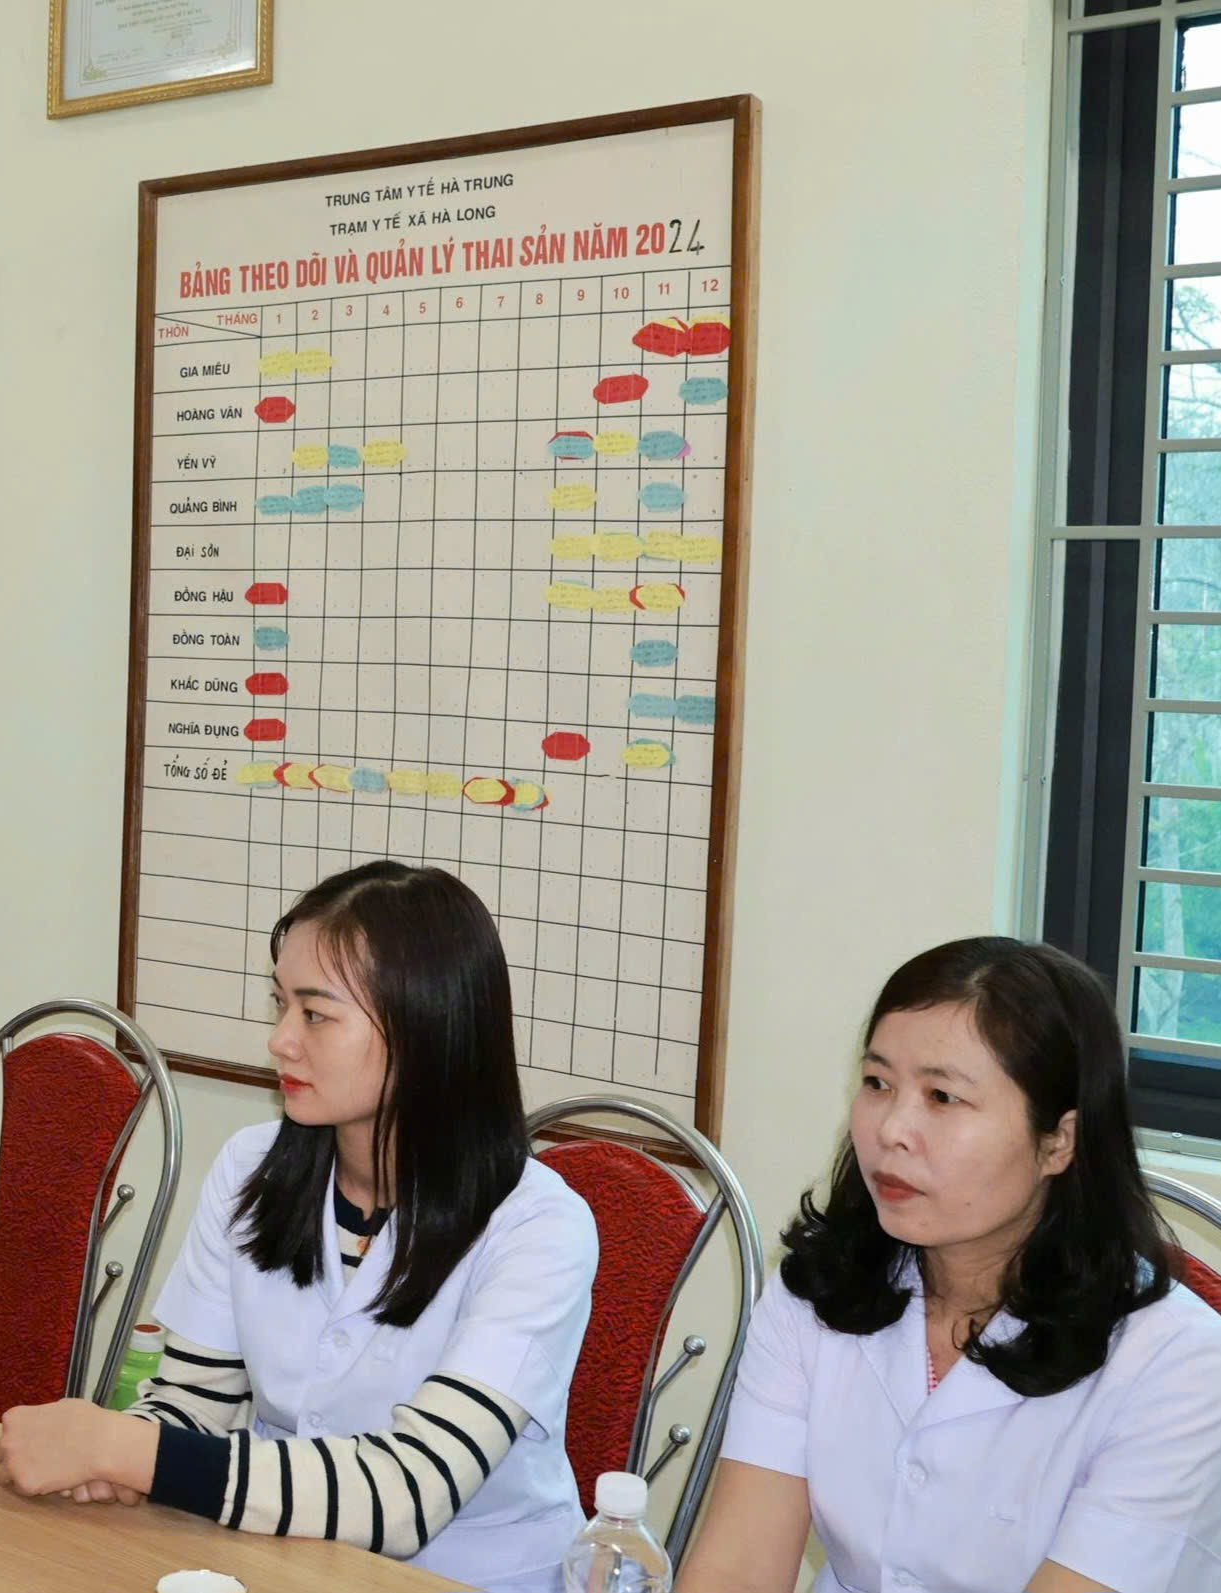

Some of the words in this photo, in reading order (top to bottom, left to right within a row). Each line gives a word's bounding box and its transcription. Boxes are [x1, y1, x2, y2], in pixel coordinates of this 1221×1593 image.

[325, 191, 370, 207] TRUNG
[375, 186, 402, 201] TÂM
[407, 186, 416, 198] Y
[417, 176, 435, 196] TẾ
[441, 178, 460, 194] HÀ
[464, 173, 514, 192] TRUNG
[330, 221, 367, 237] TRẠM
[372, 219, 381, 232] Y
[384, 211, 400, 230] TẾ
[408, 211, 427, 227] XÃ
[432, 208, 451, 225] HÀ
[457, 205, 496, 221] LONG
[180, 262, 230, 299] BẢNG
[239, 261, 289, 293] THEO
[296, 252, 327, 288] DÕI
[334, 249, 359, 284] VÀ
[365, 239, 424, 283] QUẢN
[431, 236, 455, 275] LÝ
[462, 237, 513, 272] THAI
[519, 224, 566, 266] SẢN
[573, 222, 628, 262] NĂM
[635, 218, 705, 256] 2024
[217, 312, 258, 326] THÁNG
[277, 314, 282, 325] 1
[312, 309, 319, 321] 2
[346, 304, 353, 317] 3
[382, 304, 390, 316] 4
[419, 302, 427, 315] 5
[455, 297, 464, 309] 6
[497, 296, 505, 308] 7
[535, 293, 544, 305] 8
[576, 290, 585, 302] 9
[613, 287, 630, 300] 10
[658, 283, 671, 296] 11
[701, 279, 719, 293] 12
[158, 325, 189, 339] THÔN
[180, 366, 198, 378] GIA
[202, 361, 230, 376] MIÊU
[177, 408, 215, 422] HOÀNG
[170, 496, 208, 514] QUẢNG
[212, 499, 237, 512] BÌNH
[174, 586, 207, 602] ĐỒNG
[212, 588, 234, 603] HẬU
[173, 628, 205, 645] ĐỒNG
[210, 633, 240, 646] TOÀN
[171, 676, 200, 691] KHẮC
[204, 677, 238, 693] DŨNG
[168, 721, 200, 735] NGHĨA
[204, 724, 239, 739] ĐỤNG
[193, 757, 210, 780] SỐ
[211, 759, 228, 780] ĐẺ
